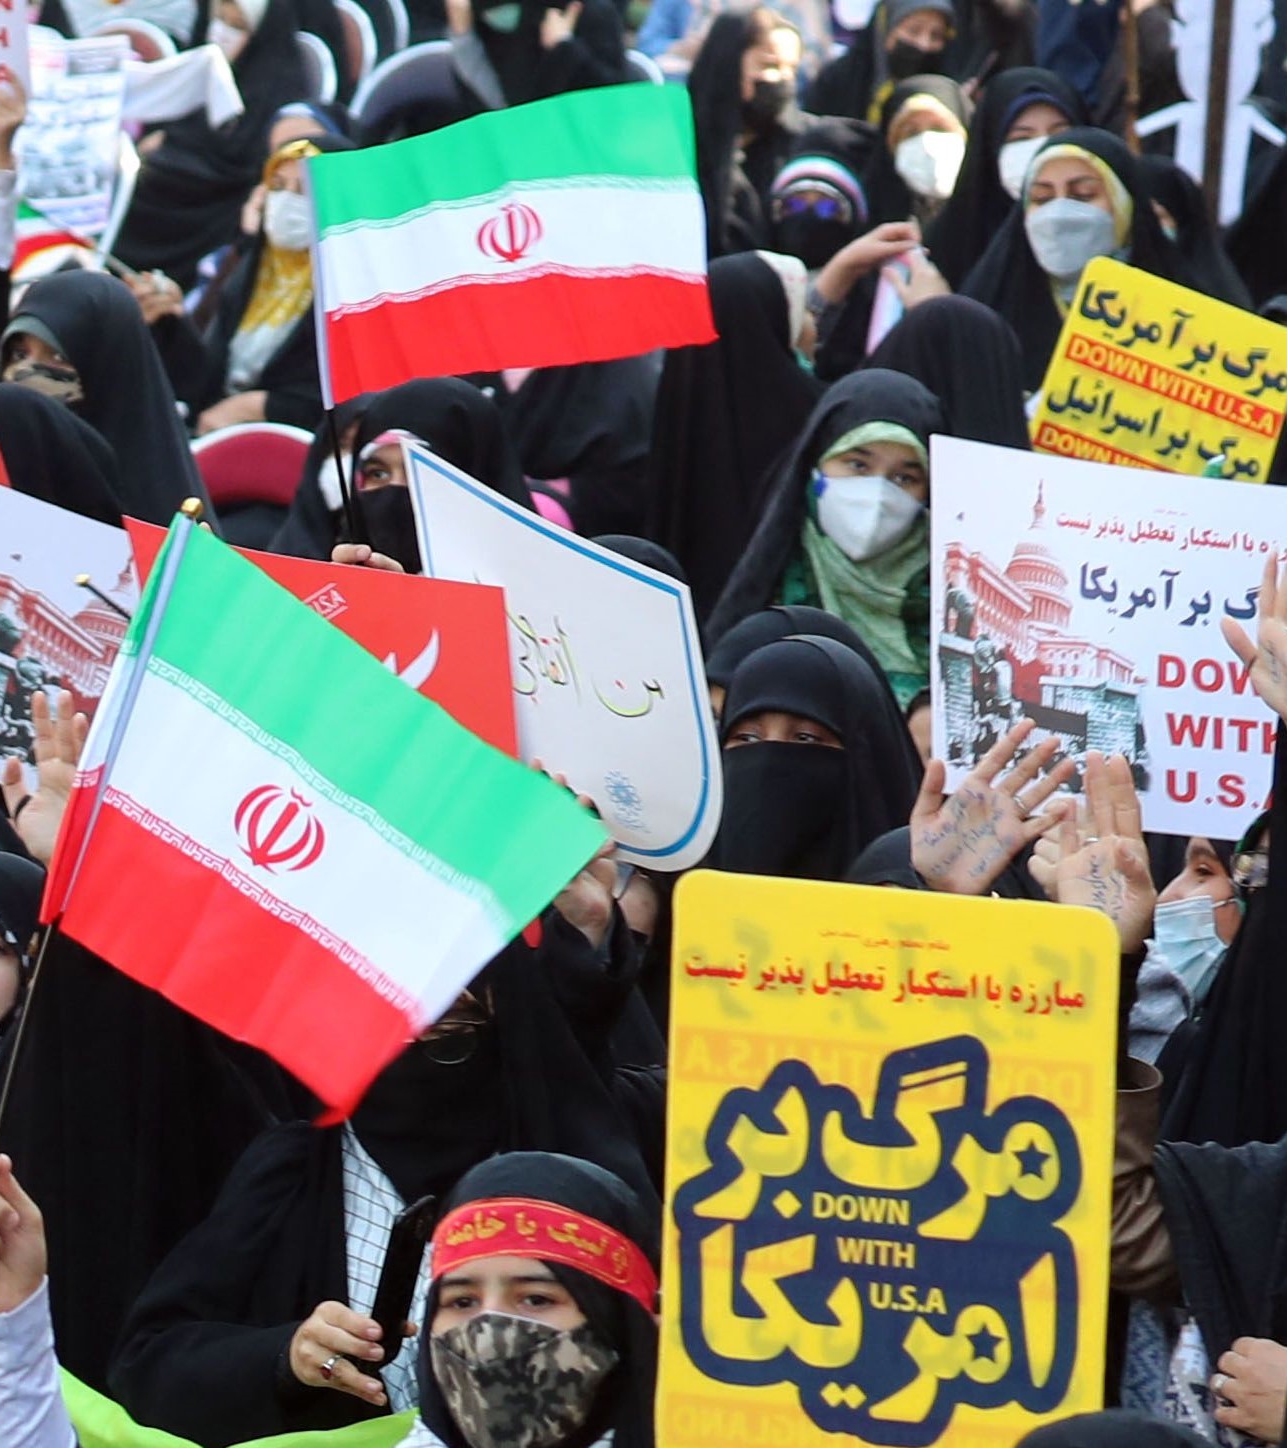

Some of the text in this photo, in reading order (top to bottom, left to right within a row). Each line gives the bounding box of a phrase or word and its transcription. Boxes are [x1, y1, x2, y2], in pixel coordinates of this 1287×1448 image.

[1080, 283, 1194, 348] آمریکا
[1177, 341, 1217, 376] بر
[1046, 376, 1163, 438] اسرائیل
[1069, 338, 1274, 434] DOWN WITH U.S.A
[1155, 431, 1189, 460] بر
[1080, 560, 1182, 618] آمریکا
[1179, 590, 1212, 626] بر
[1157, 654, 1261, 698] DOW
[1166, 770, 1275, 810] U.S.
[684, 952, 1087, 1014] مبارزه با استکبار تعطیل پذیر نیست
[692, 1060, 1061, 1241] مرگ بر
[514, 1211, 539, 1243] یا
[812, 1190, 911, 1227] DOWN
[836, 1235, 916, 1269] WITH
[868, 1280, 947, 1315] U.S.A
[700, 1222, 1058, 1424] امریکا
